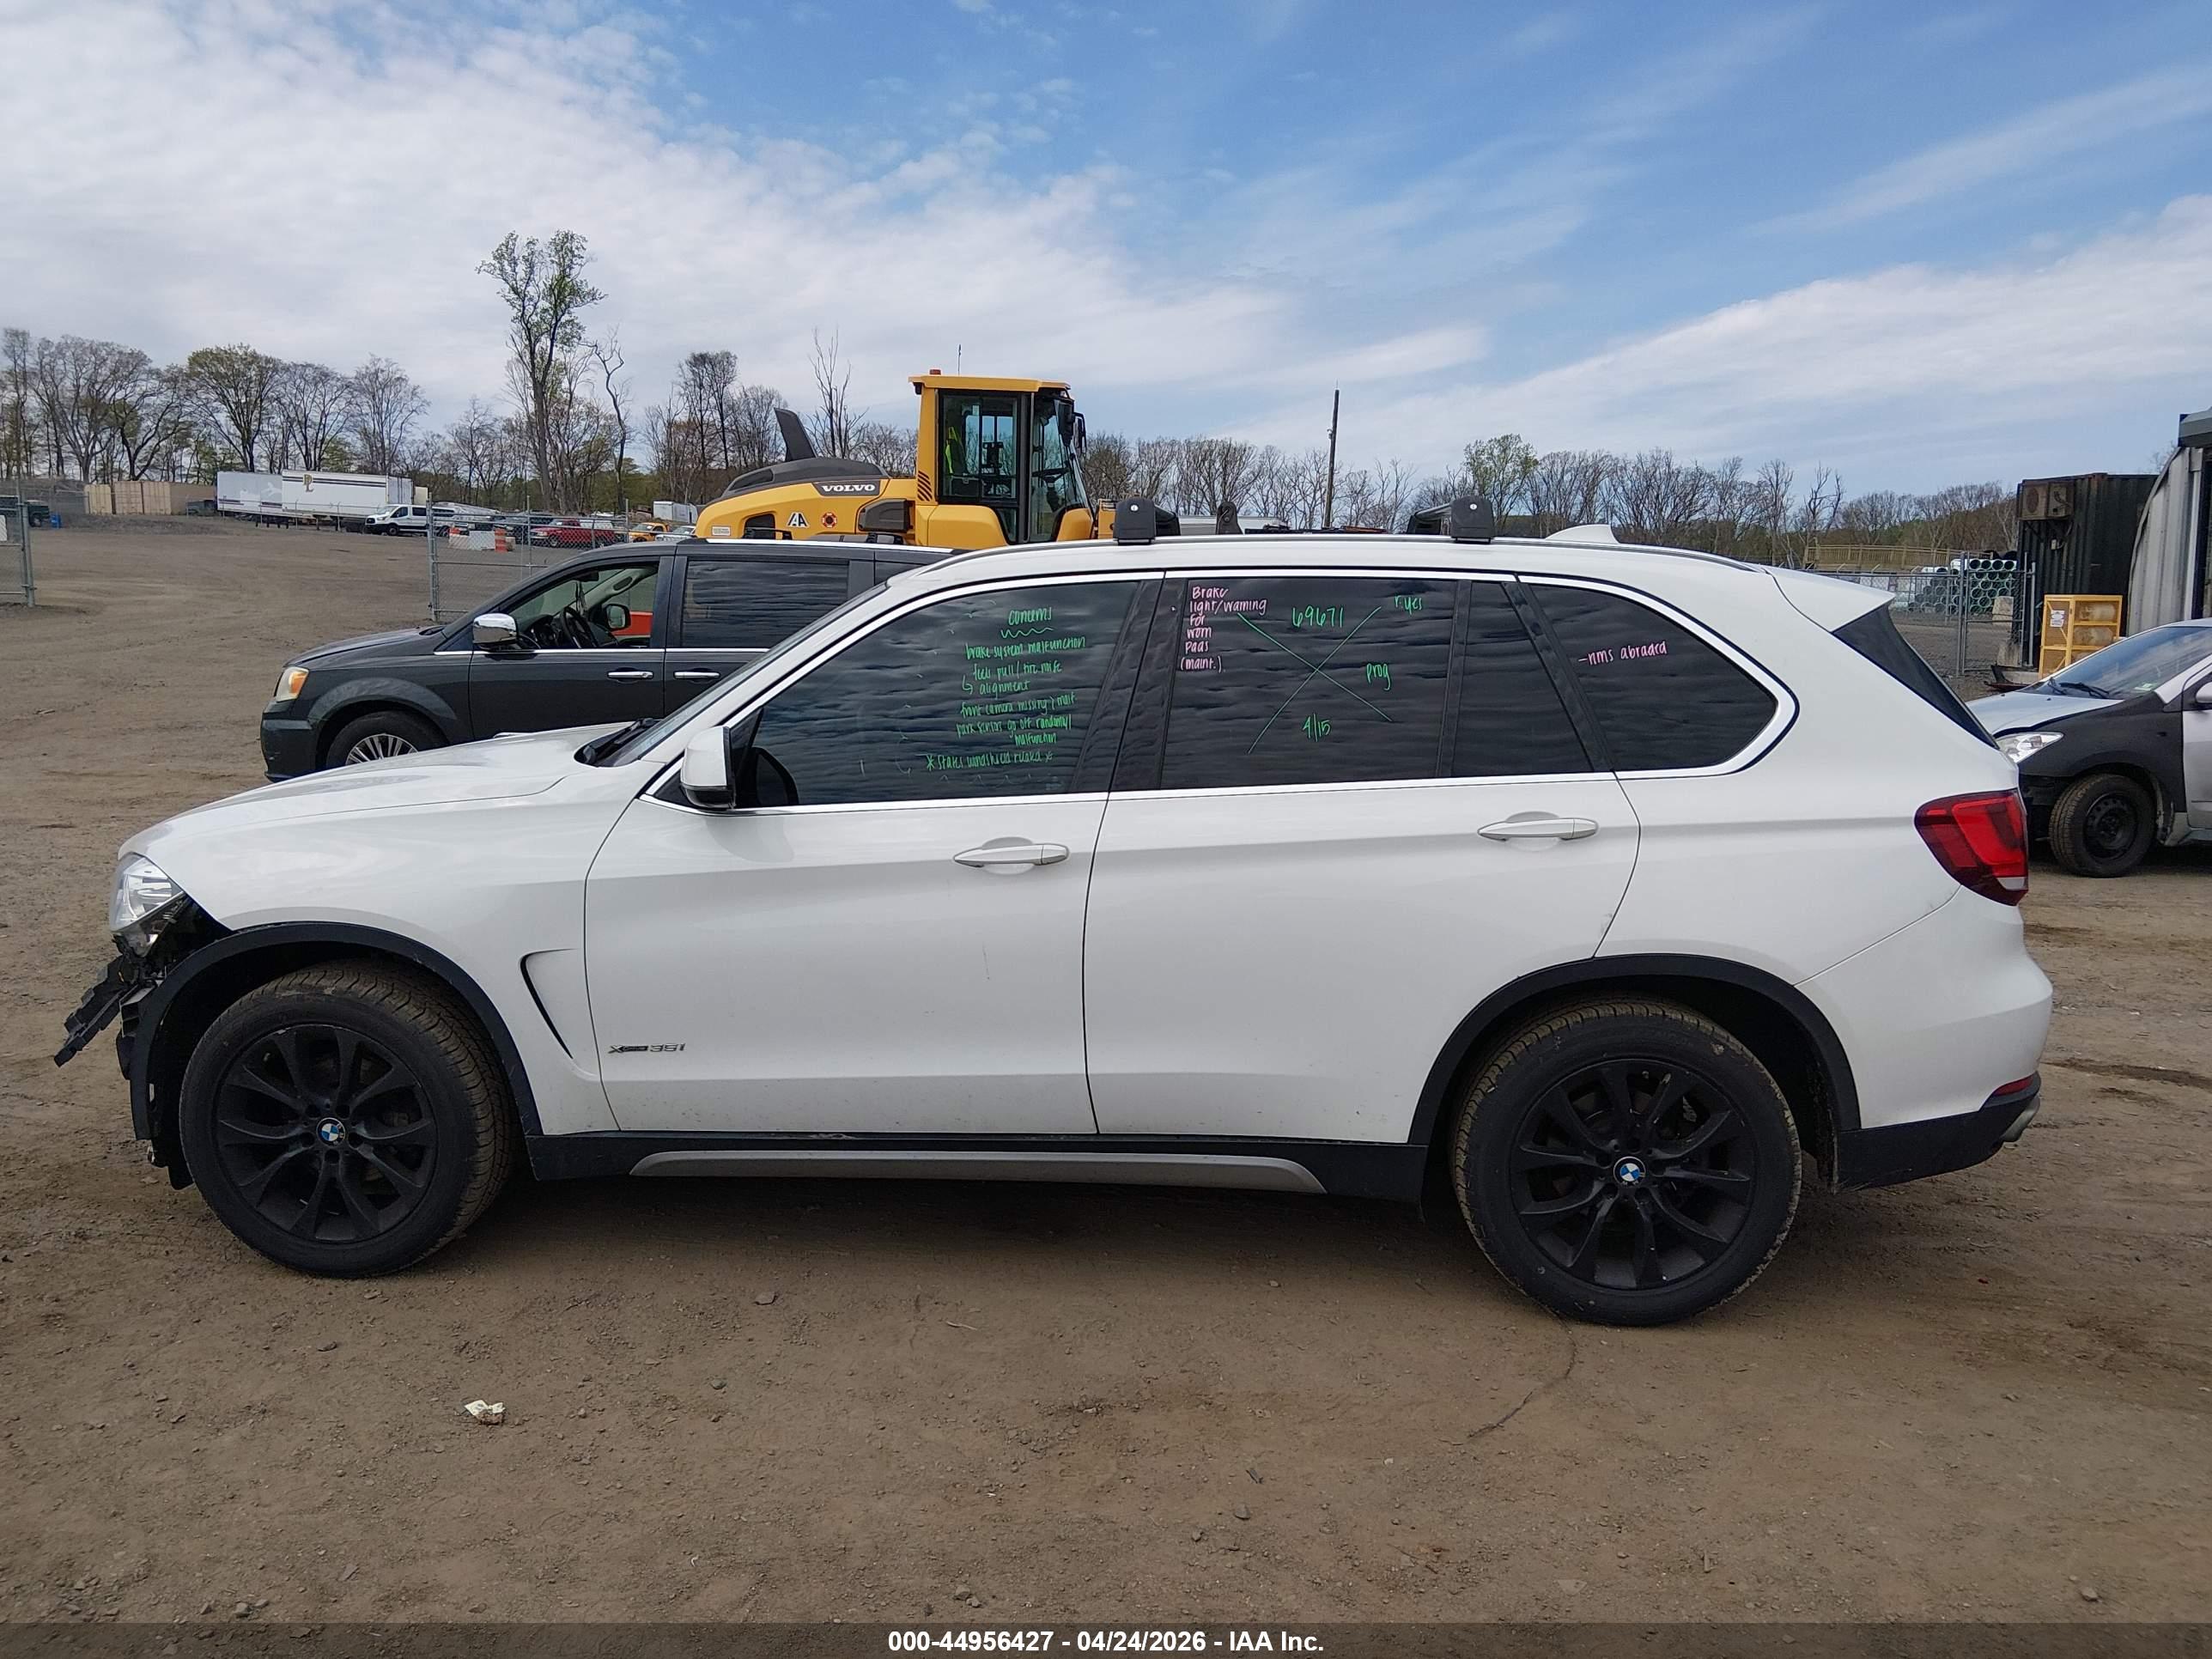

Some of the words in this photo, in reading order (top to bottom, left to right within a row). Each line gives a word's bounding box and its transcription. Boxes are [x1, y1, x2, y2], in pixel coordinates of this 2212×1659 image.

[1192, 586, 1229, 599] Brake
[1292, 605, 1344, 628] 69671
[1187, 627, 1212, 639] worn
[965, 642, 990, 659] brake
[994, 643, 1024, 660] system
[1185, 641, 1209, 655] pads
[985, 702, 1013, 715] camera
[1302, 713, 1331, 742] 4/15
